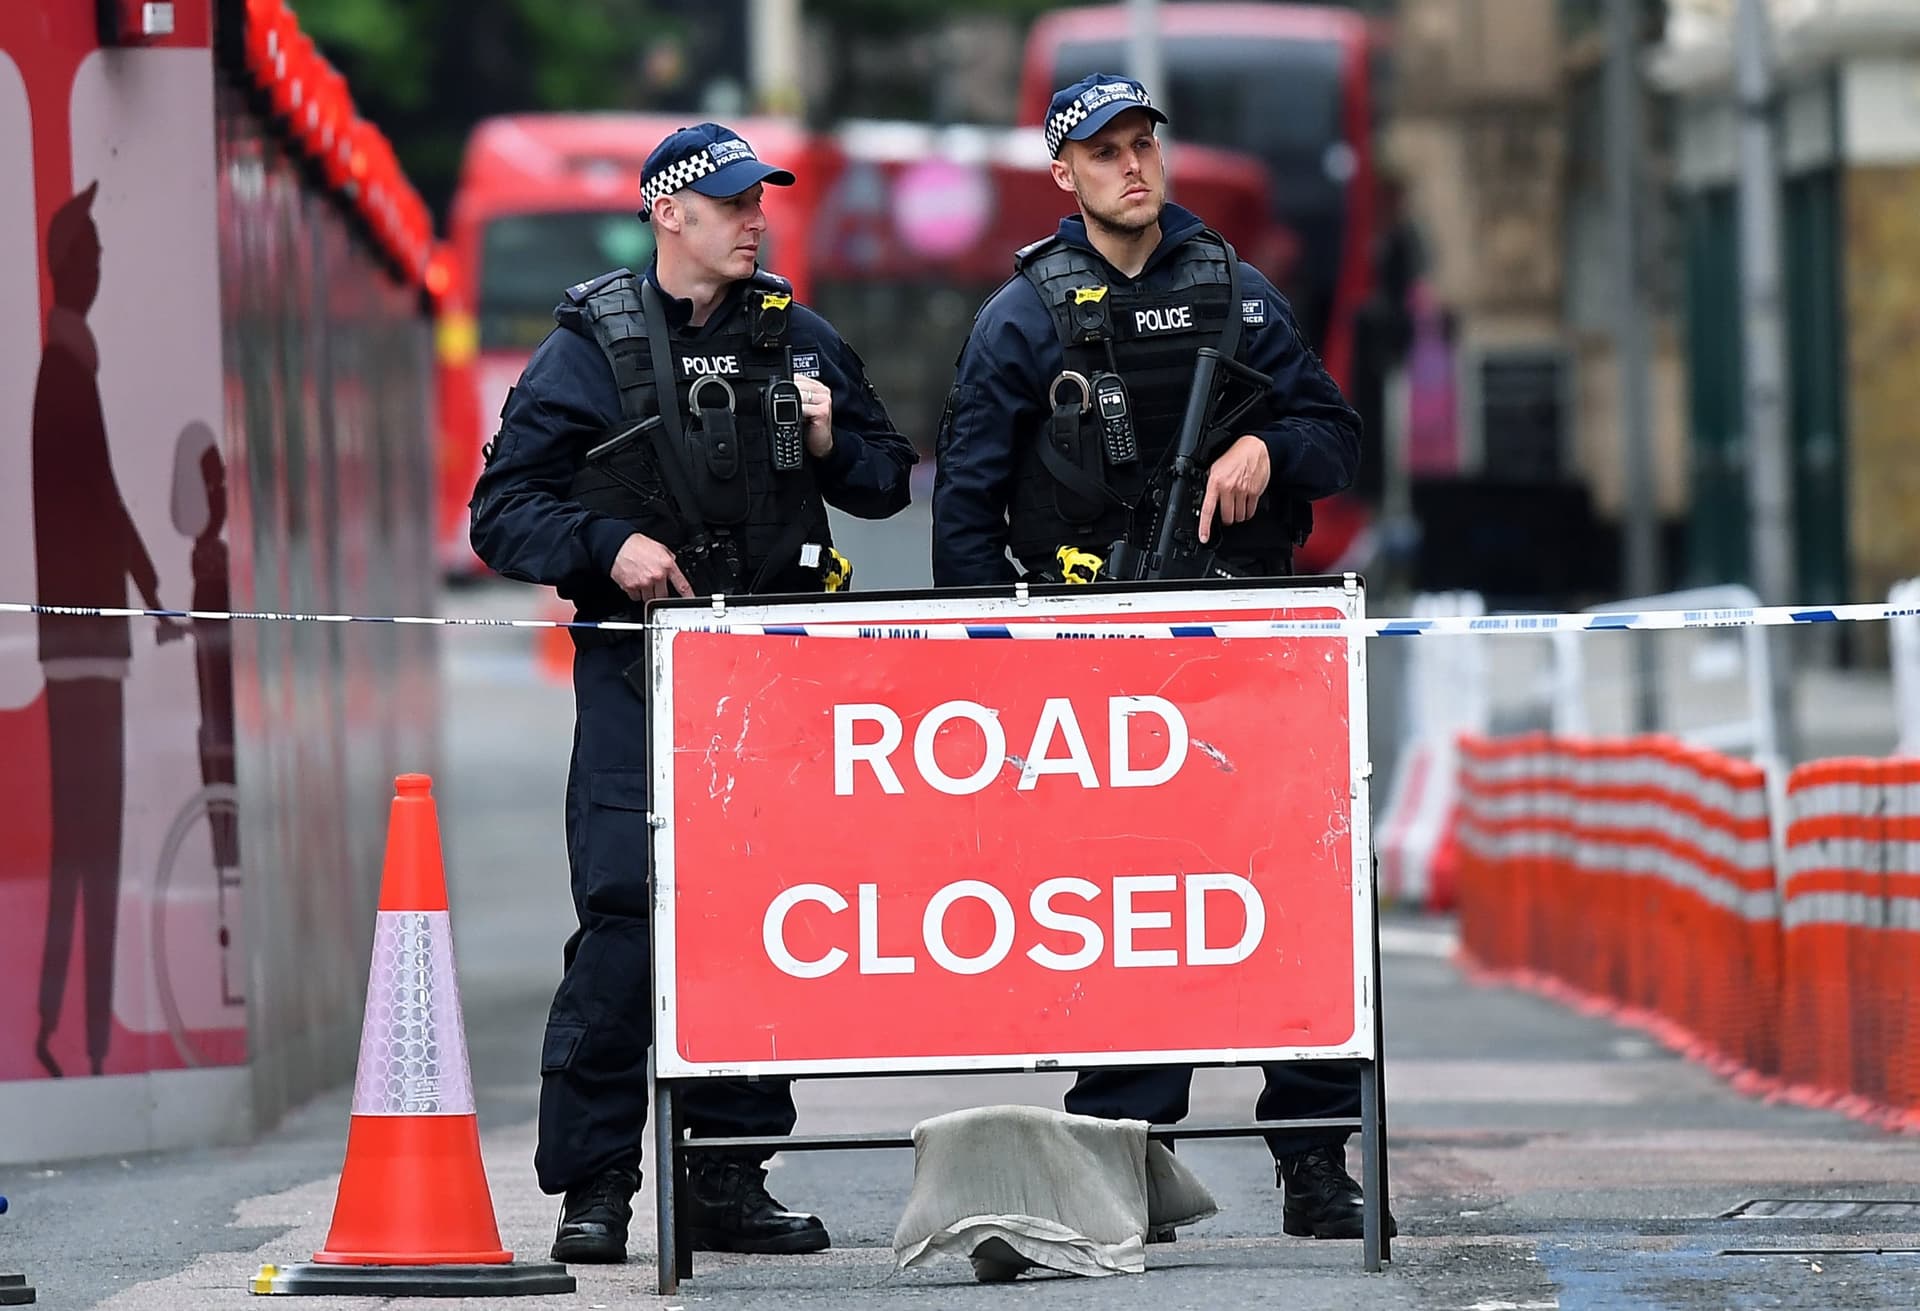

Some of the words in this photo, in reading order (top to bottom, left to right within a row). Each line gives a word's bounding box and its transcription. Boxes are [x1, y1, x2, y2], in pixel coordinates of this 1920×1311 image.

[1135, 306, 1192, 332] POLICE
[682, 356, 739, 375] POLICE
[834, 695, 1189, 795] ROAD
[762, 873, 1265, 978] CLOSED
